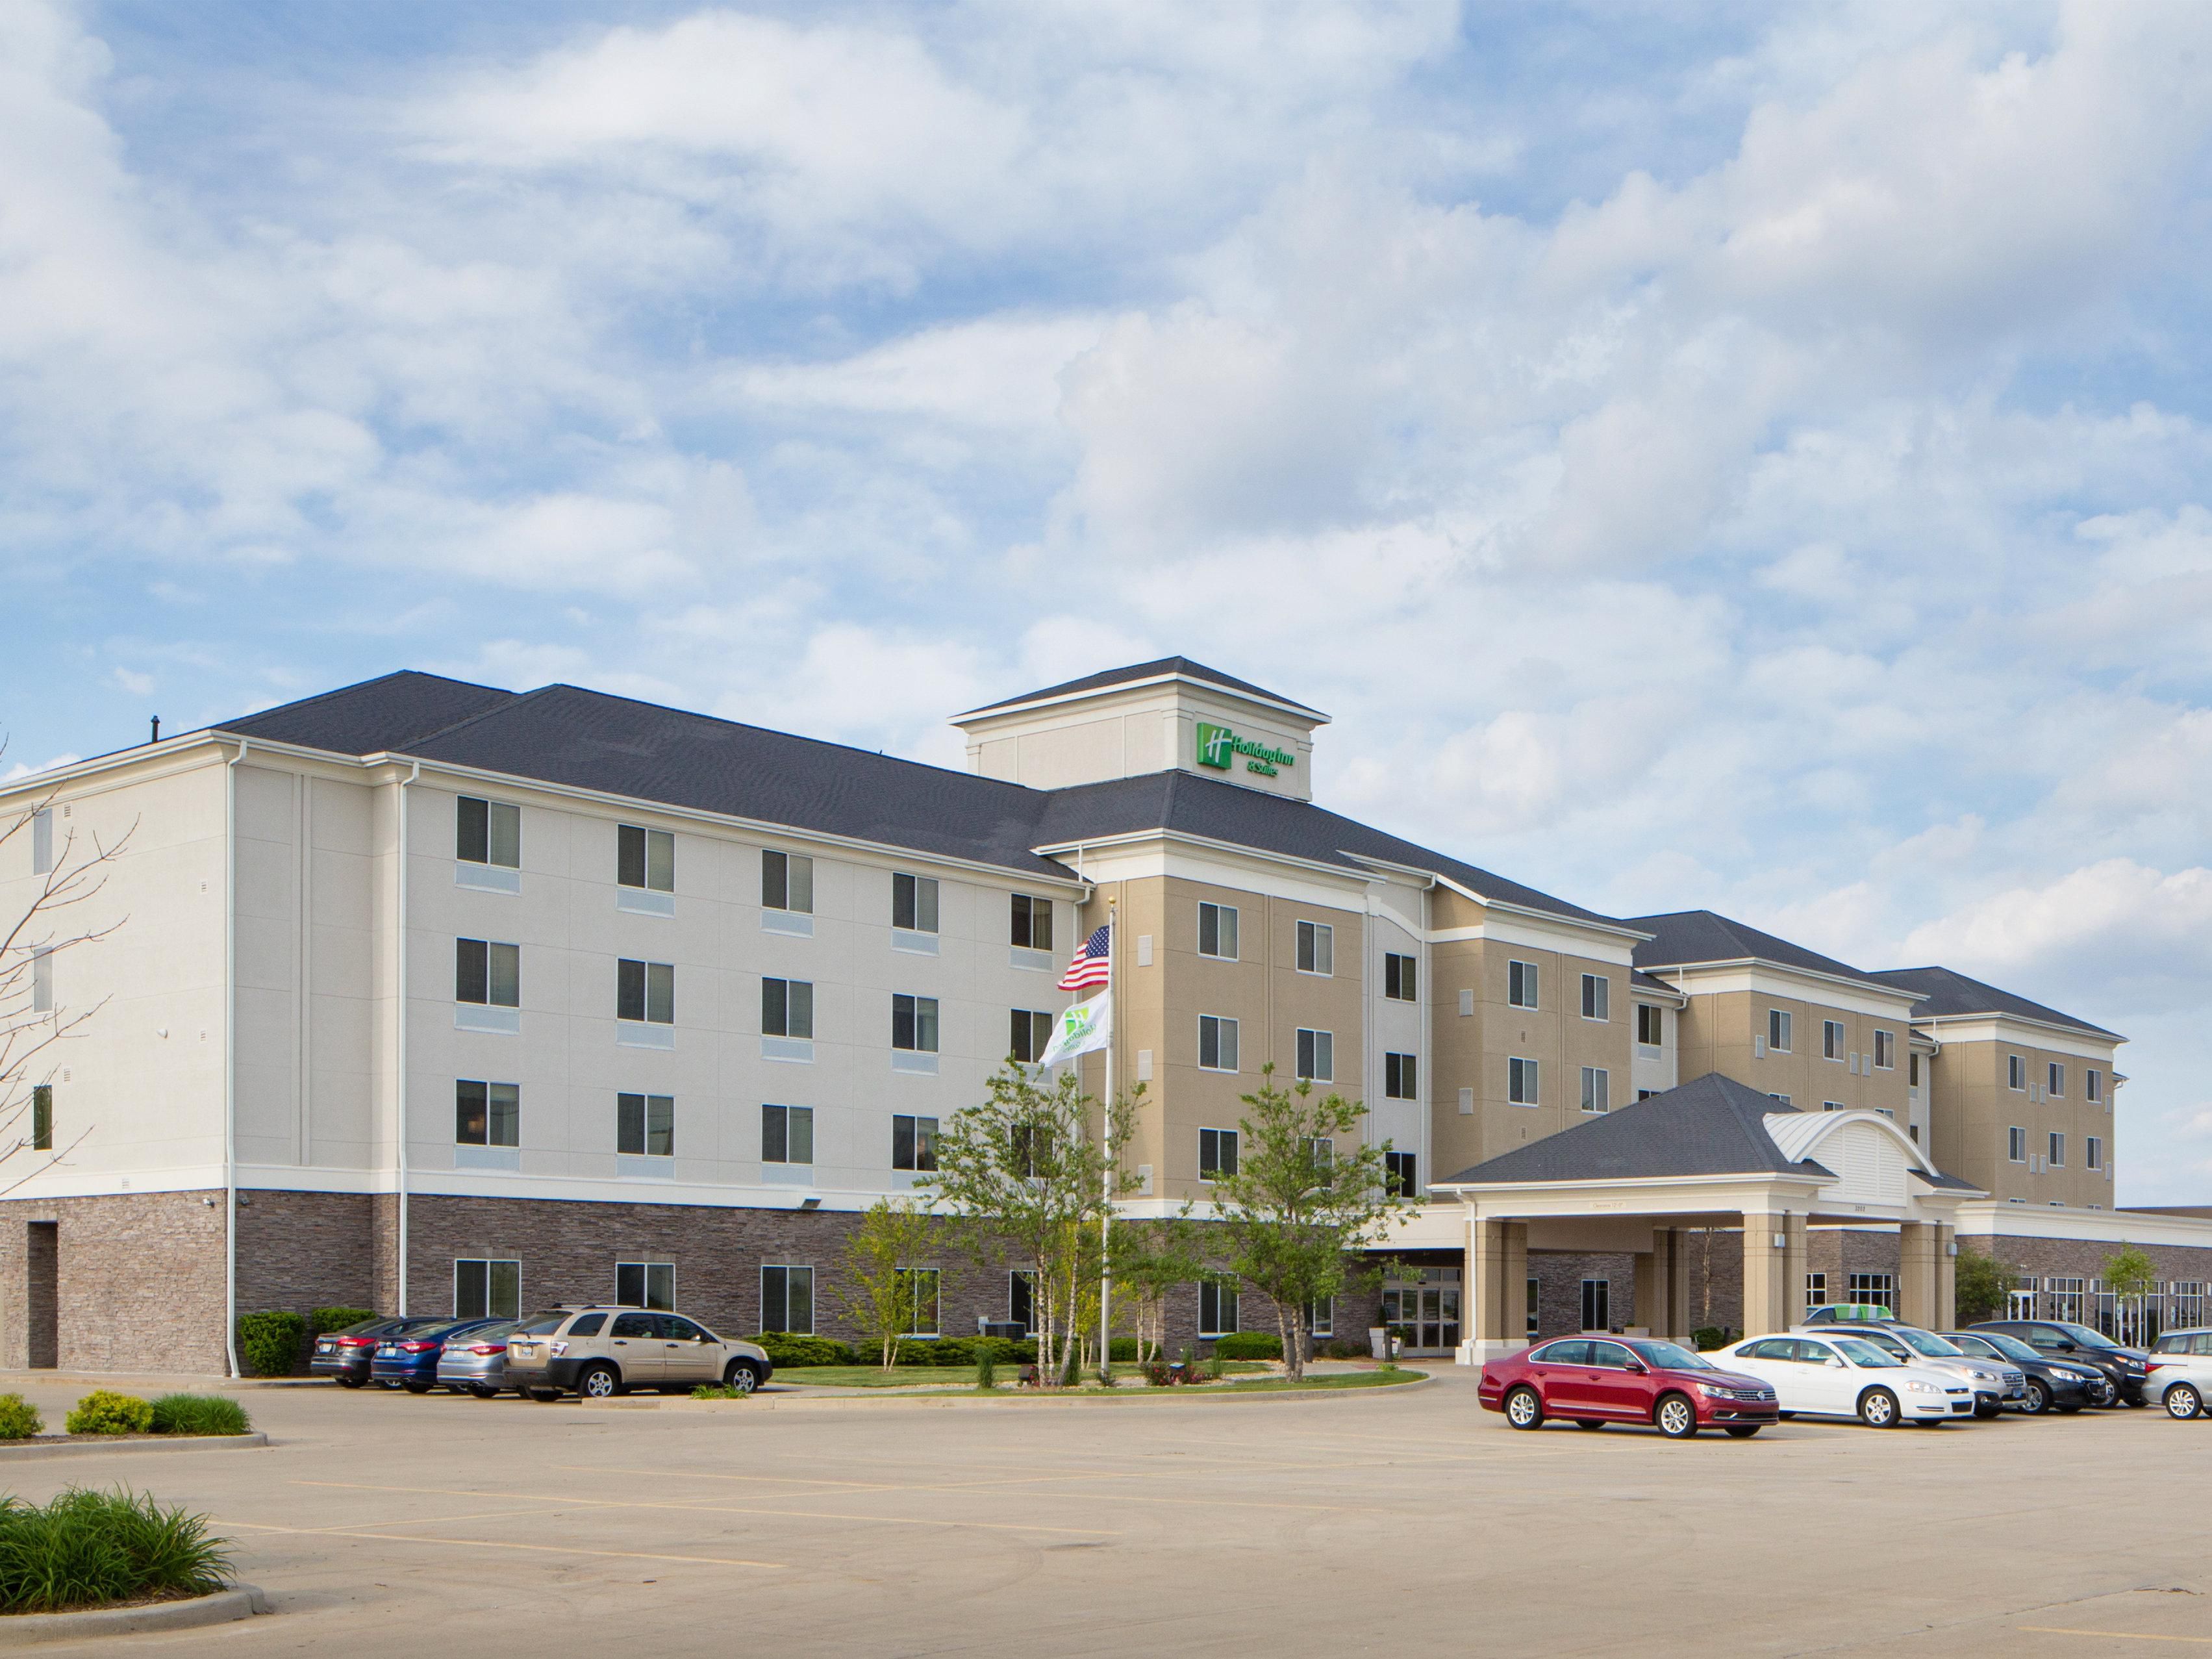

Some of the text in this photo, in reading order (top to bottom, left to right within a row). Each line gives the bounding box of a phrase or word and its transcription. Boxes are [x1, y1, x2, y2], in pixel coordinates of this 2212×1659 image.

[1231, 735, 1294, 765] Holiday Inn
[1255, 762, 1278, 777] Suites
